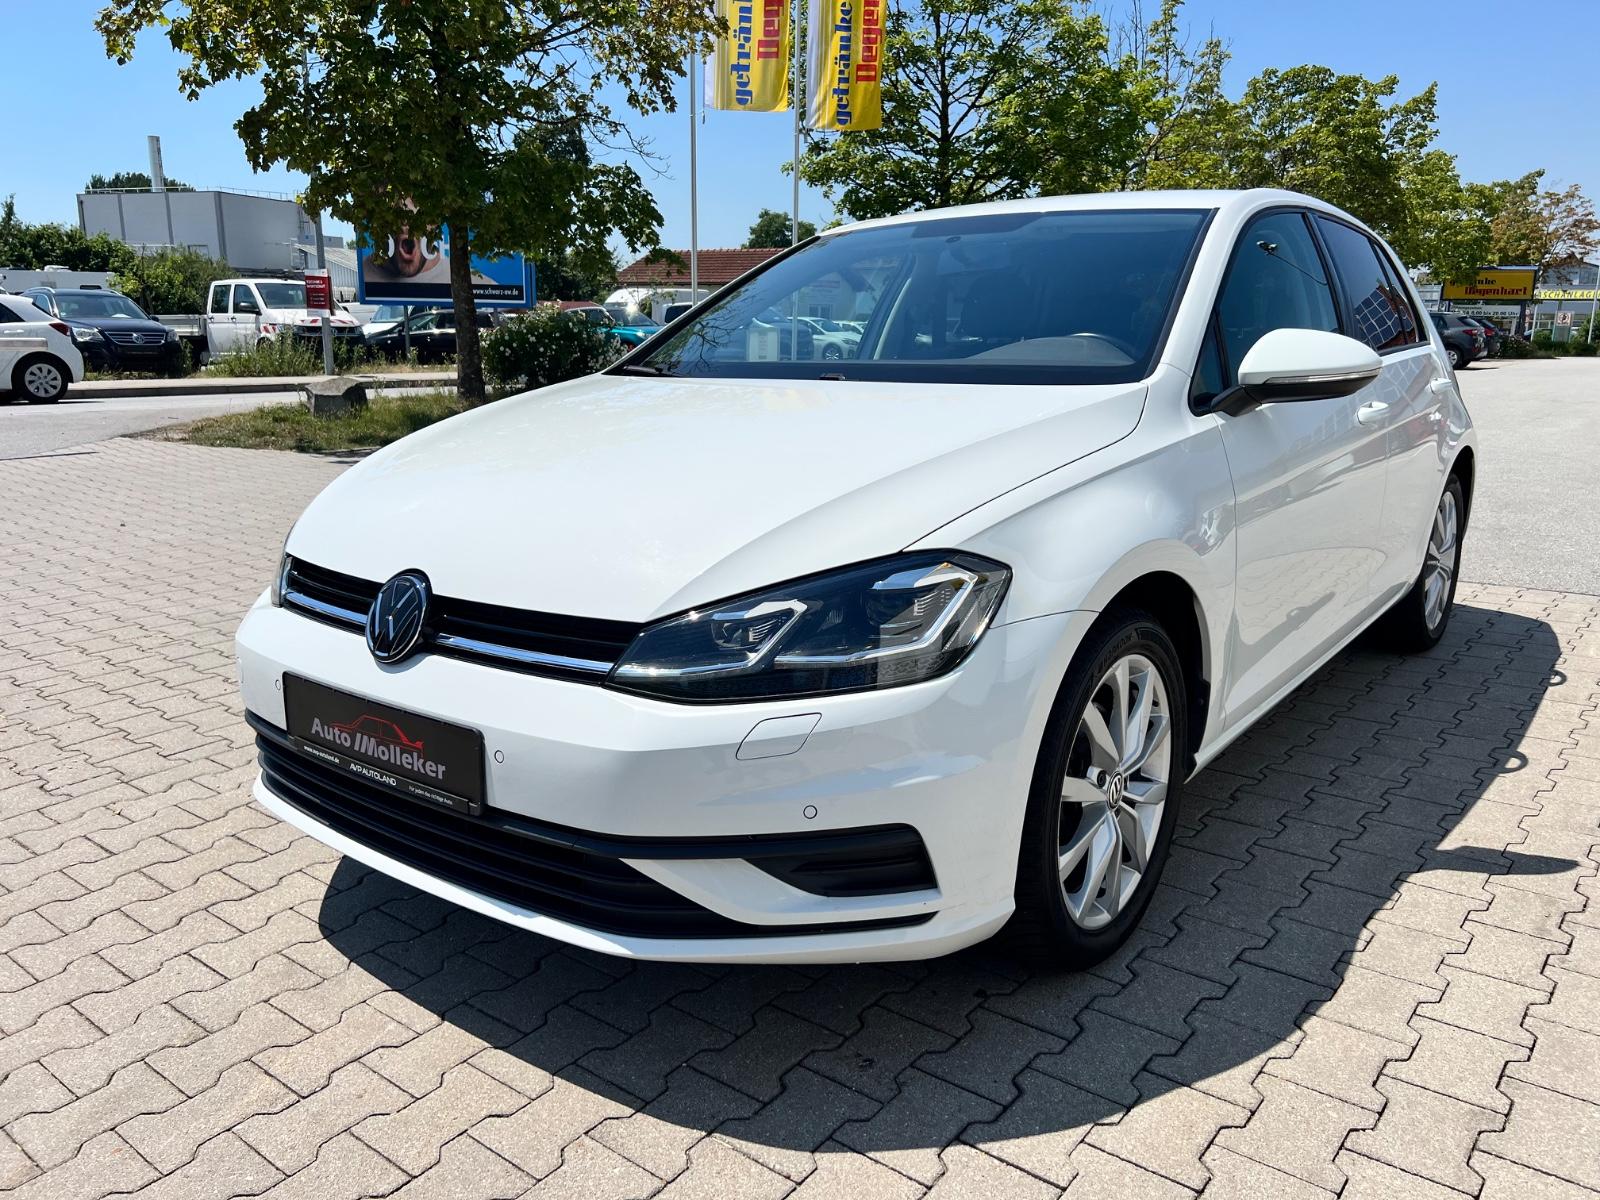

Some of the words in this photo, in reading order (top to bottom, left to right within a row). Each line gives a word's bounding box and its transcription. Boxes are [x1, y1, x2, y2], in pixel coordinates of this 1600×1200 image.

[731, 0, 753, 106] geträn
[832, 1, 853, 126] getränke
[311, 717, 351, 748] Auto
[362, 767, 397, 786] AUTOLAND
